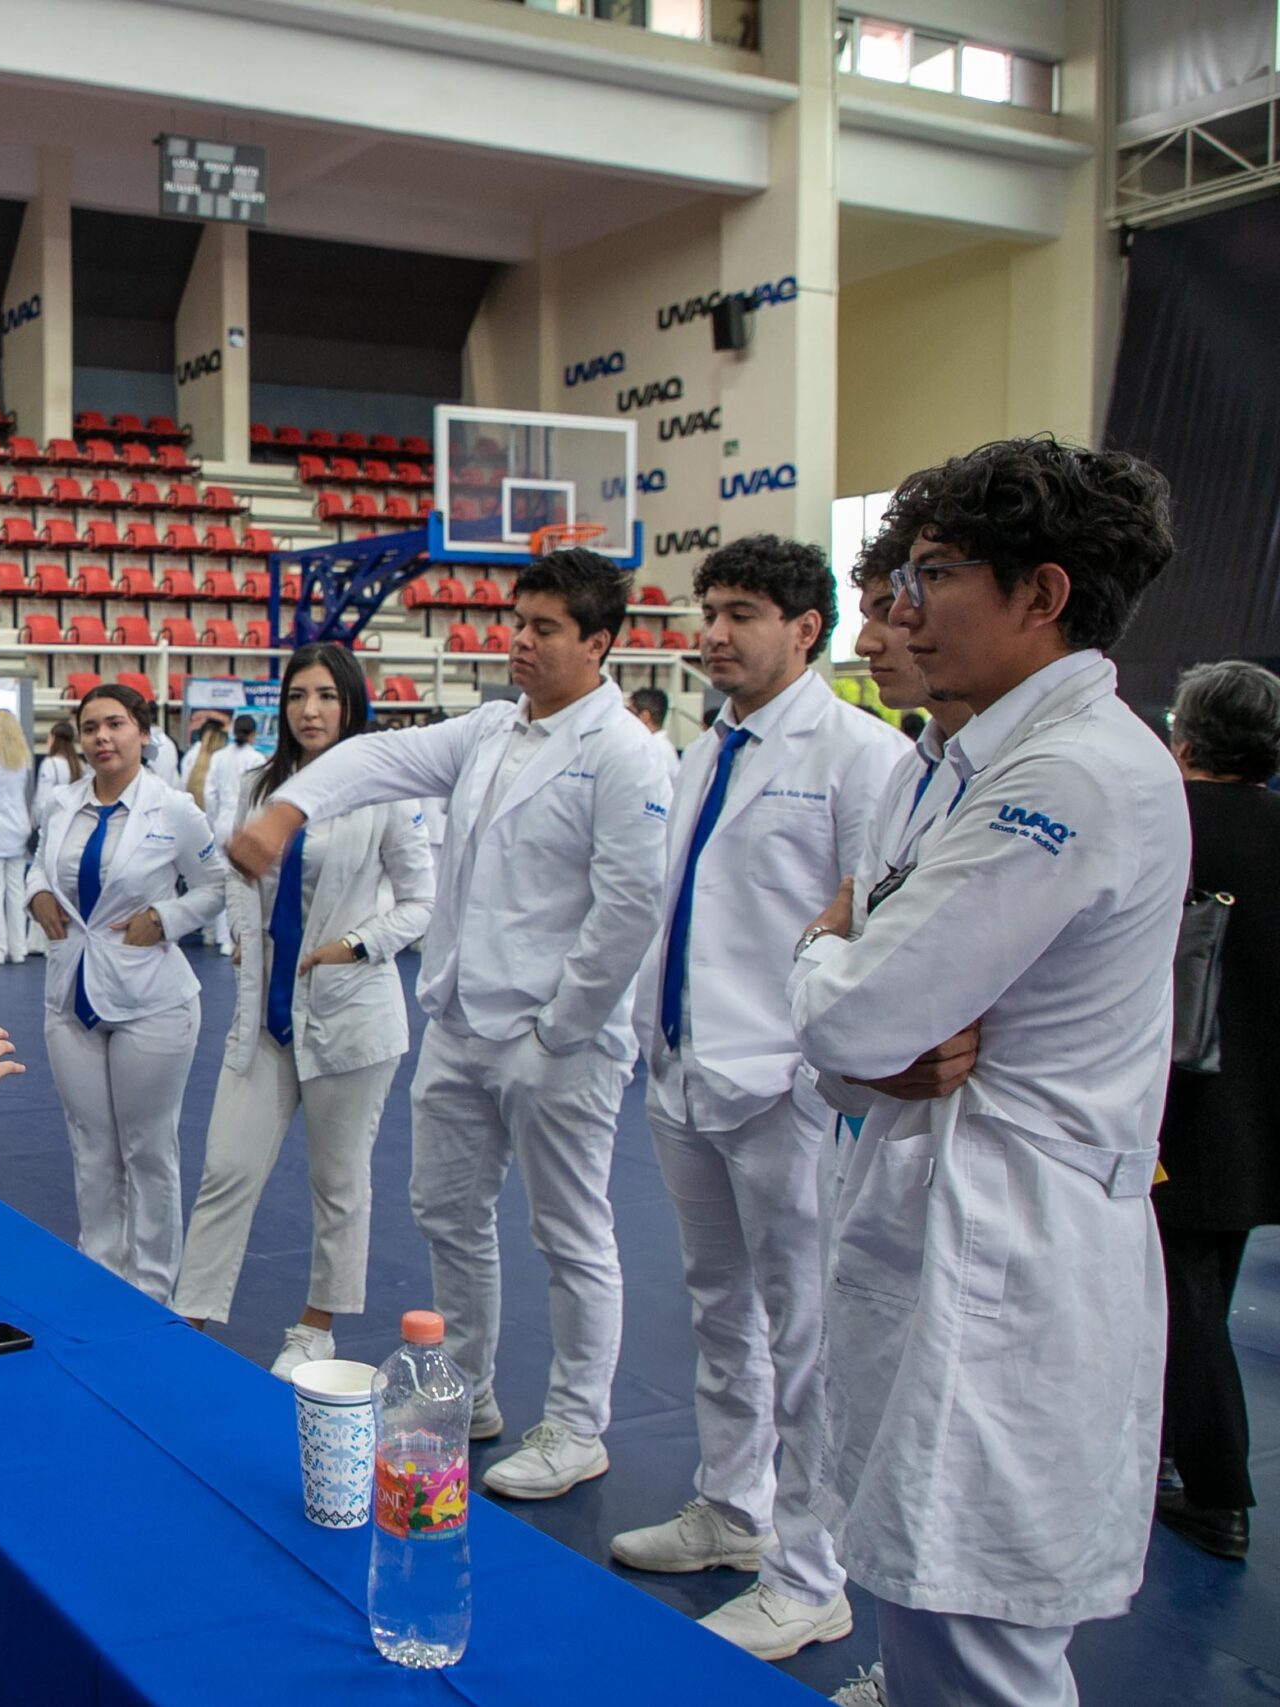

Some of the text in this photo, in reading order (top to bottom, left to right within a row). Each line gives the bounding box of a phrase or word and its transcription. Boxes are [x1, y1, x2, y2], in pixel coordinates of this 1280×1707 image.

[564, 351, 625, 387] UVAQ
[617, 377, 682, 412] UVAQ
[720, 463, 796, 500] UVAQ
[989, 821, 1018, 834] Escuela
[1019, 829, 1030, 837] de
